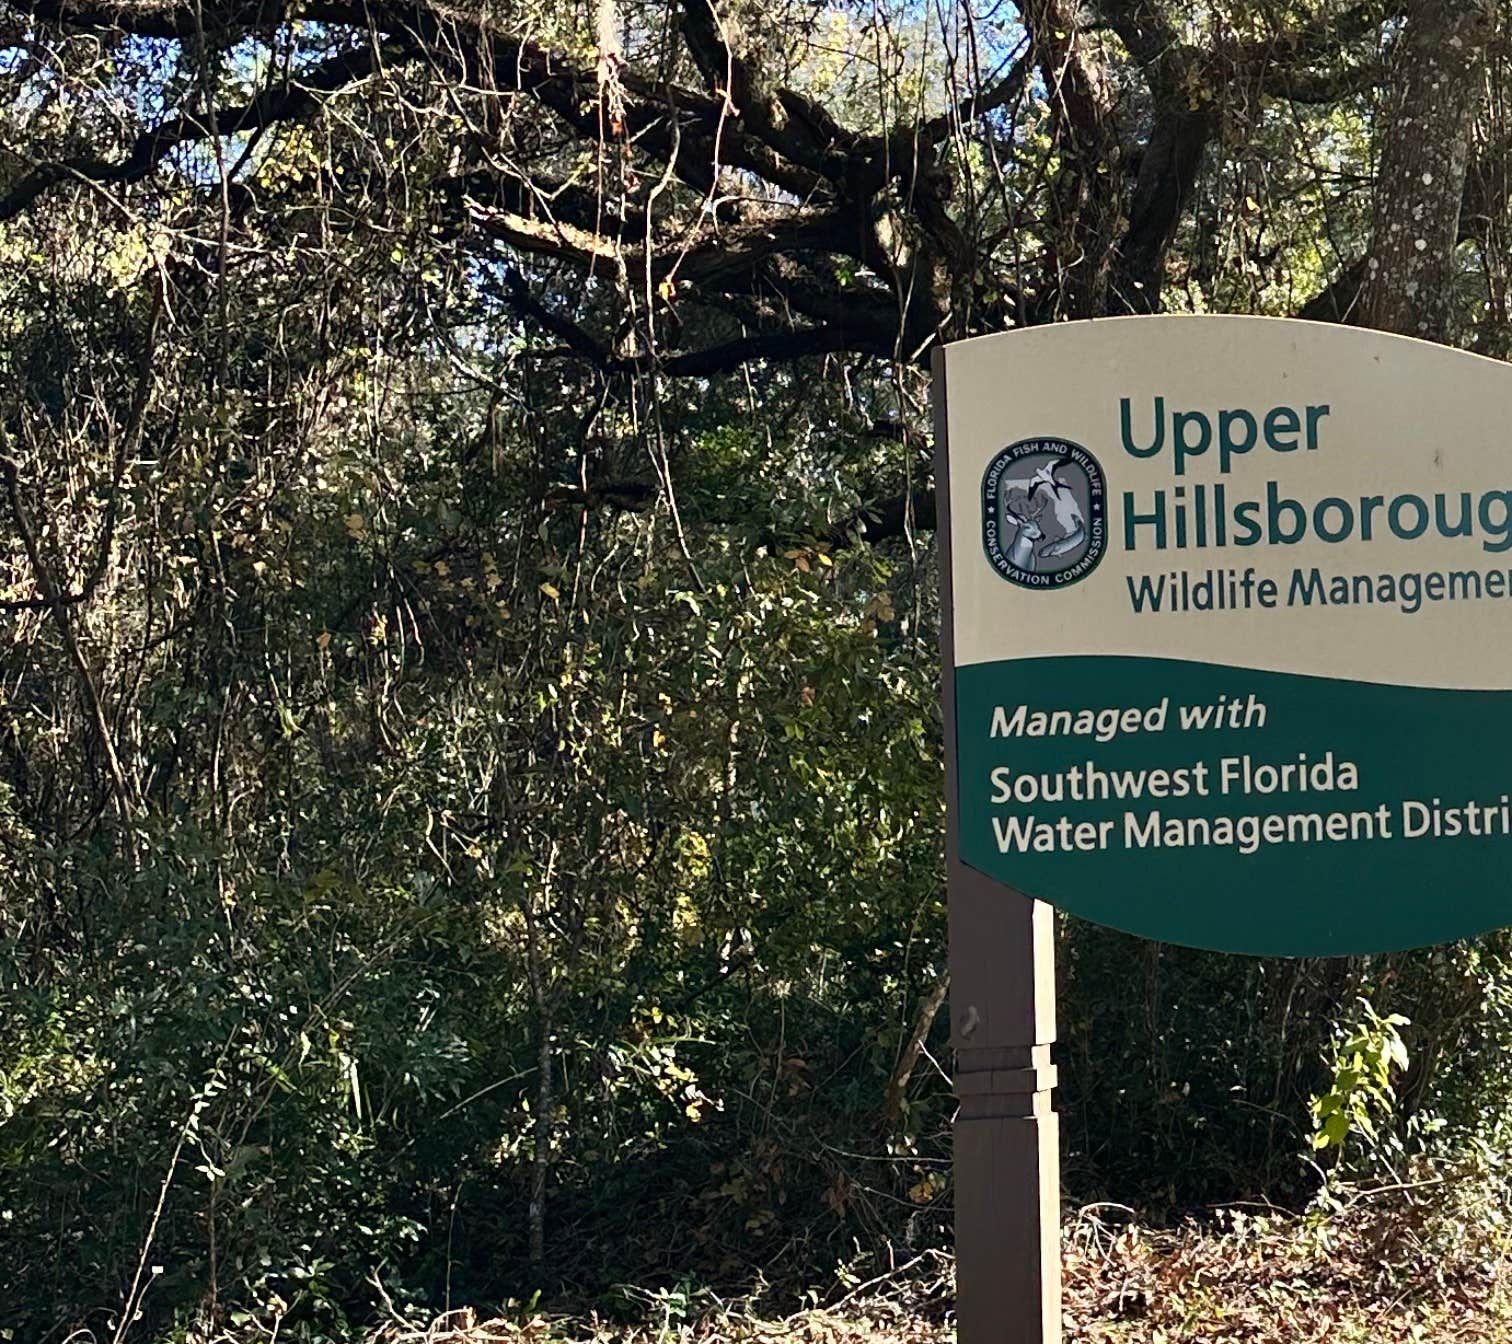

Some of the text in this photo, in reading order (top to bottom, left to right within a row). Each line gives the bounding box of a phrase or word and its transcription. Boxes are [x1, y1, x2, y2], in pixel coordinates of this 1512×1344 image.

[1119, 396, 1330, 475] Upper
[986, 442, 1102, 499] FLORIDA FISH AND WILDLIFE
[986, 519, 1102, 585] CONSERVATION COMMISSION
[1126, 567, 1278, 614] Wildlife
[990, 696, 1266, 743] Managed with
[990, 752, 1359, 804] Southwest Florida
[992, 816, 1117, 854] Water
[1124, 804, 1392, 854] Management
